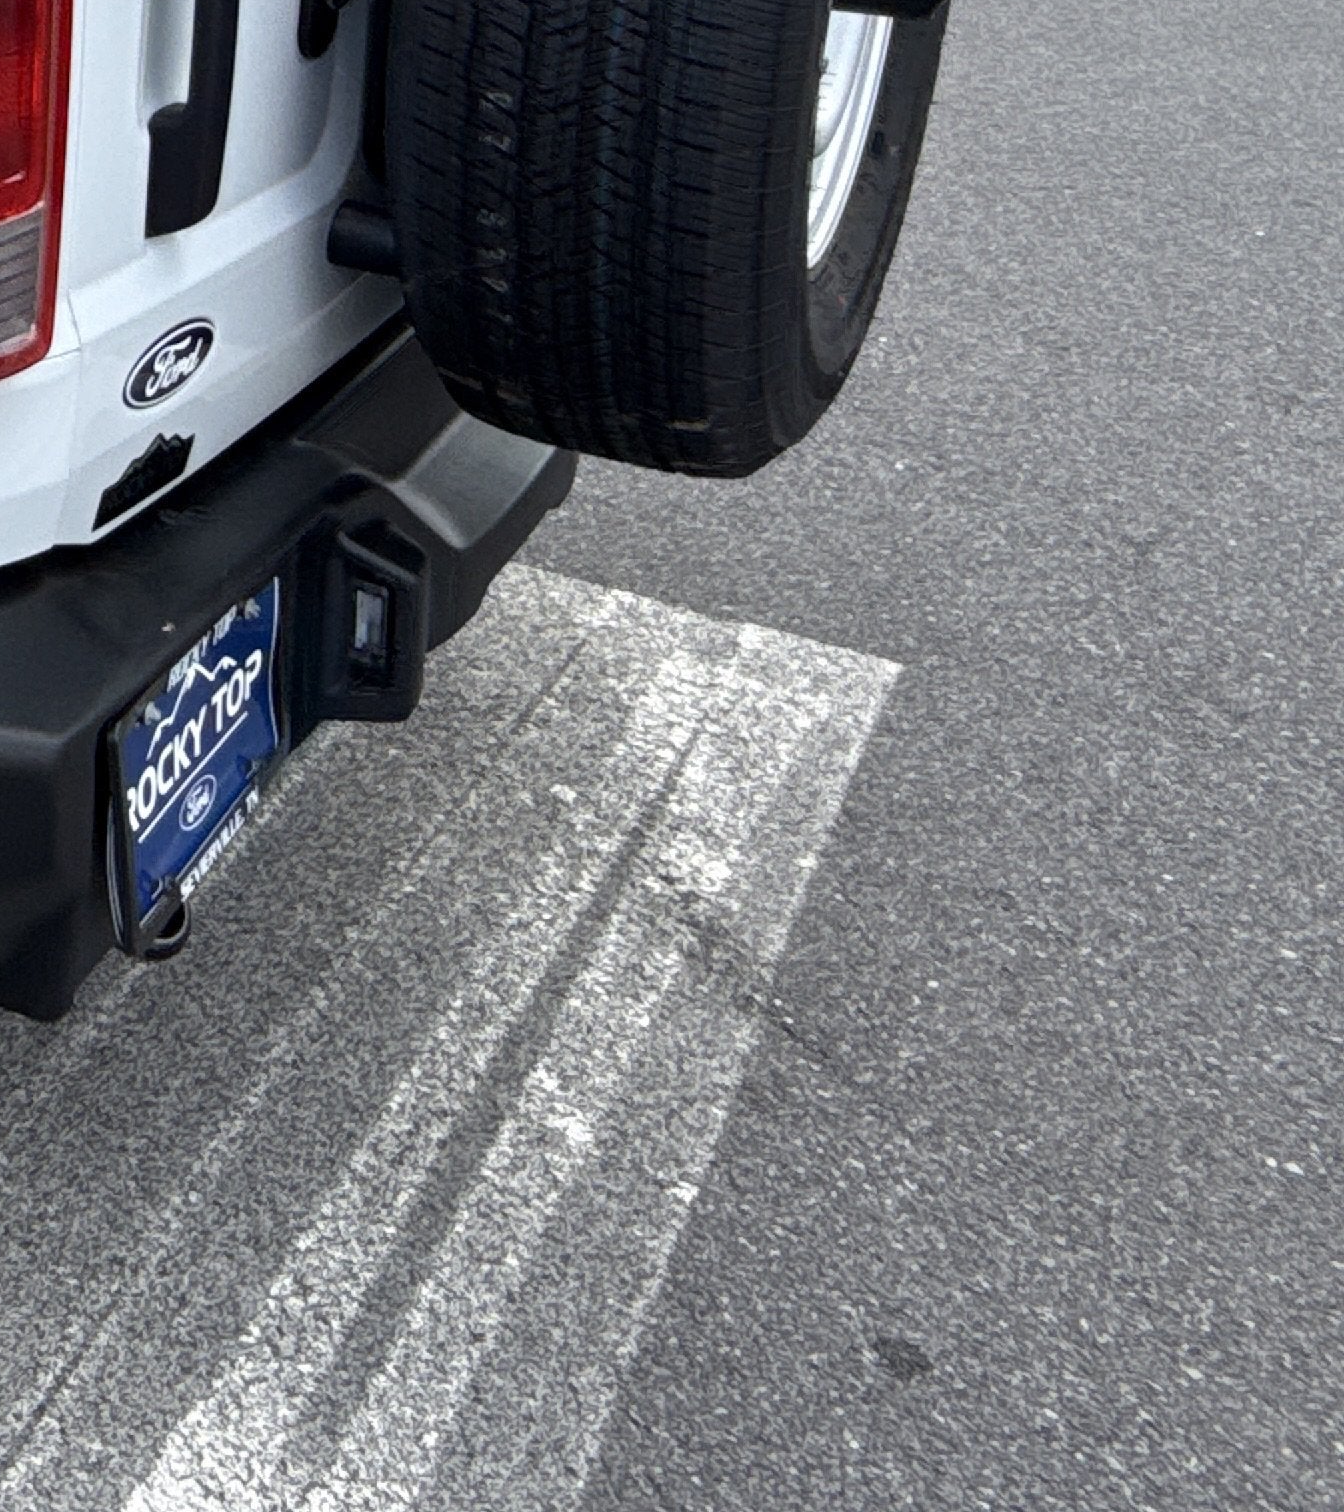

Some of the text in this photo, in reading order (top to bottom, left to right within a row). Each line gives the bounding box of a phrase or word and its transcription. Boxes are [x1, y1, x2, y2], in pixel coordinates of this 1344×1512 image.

[144, 335, 203, 398] Ford
[126, 648, 263, 833] ROCKY TOP
